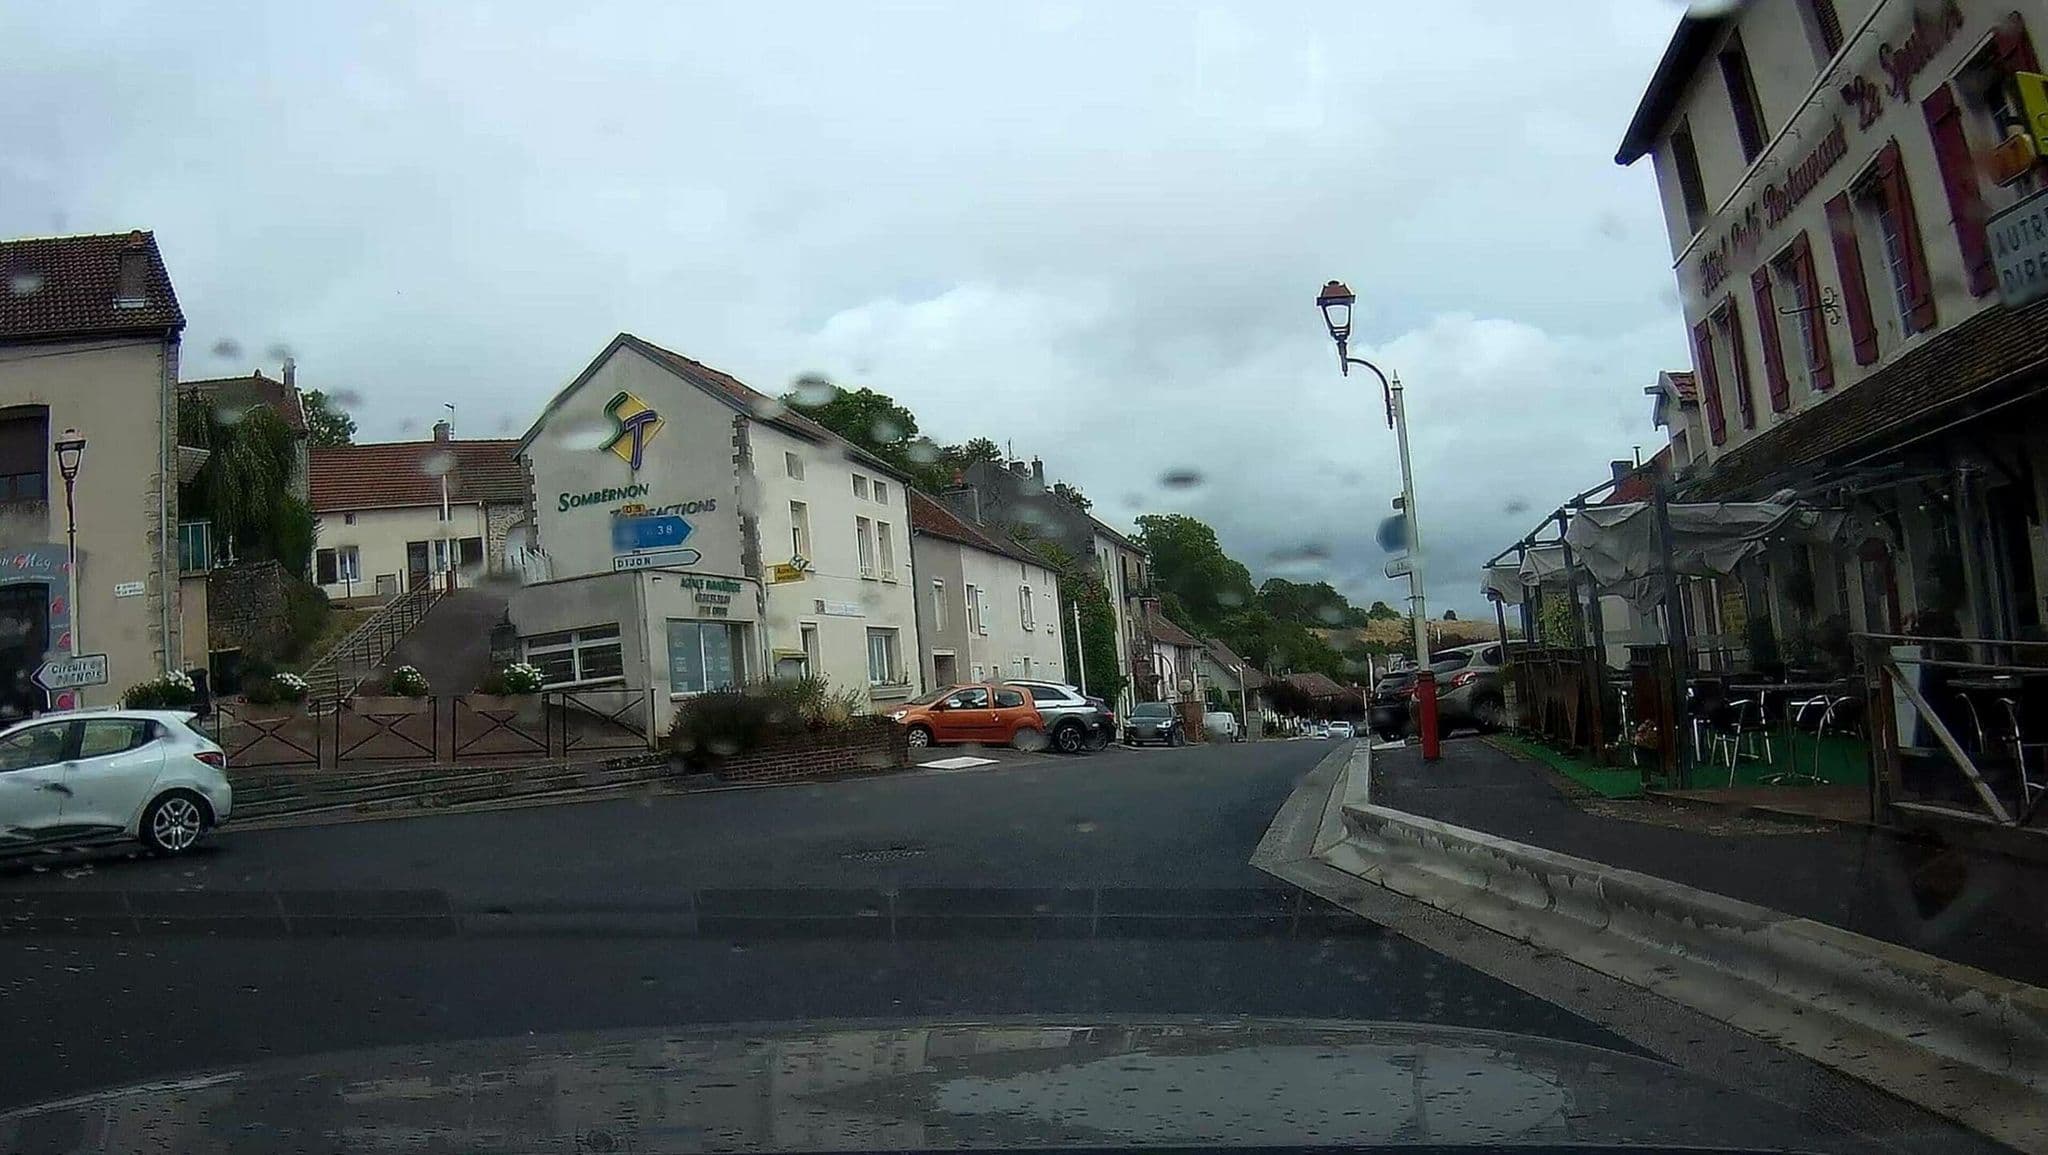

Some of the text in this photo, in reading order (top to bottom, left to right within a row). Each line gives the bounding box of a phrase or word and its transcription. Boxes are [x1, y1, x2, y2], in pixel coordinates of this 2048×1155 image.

[610, 499, 717, 518] TSACTIONS
[617, 557, 651, 568] DIJON
[51, 661, 86, 674] Circuit
[55, 671, 102, 686] PNOIS
